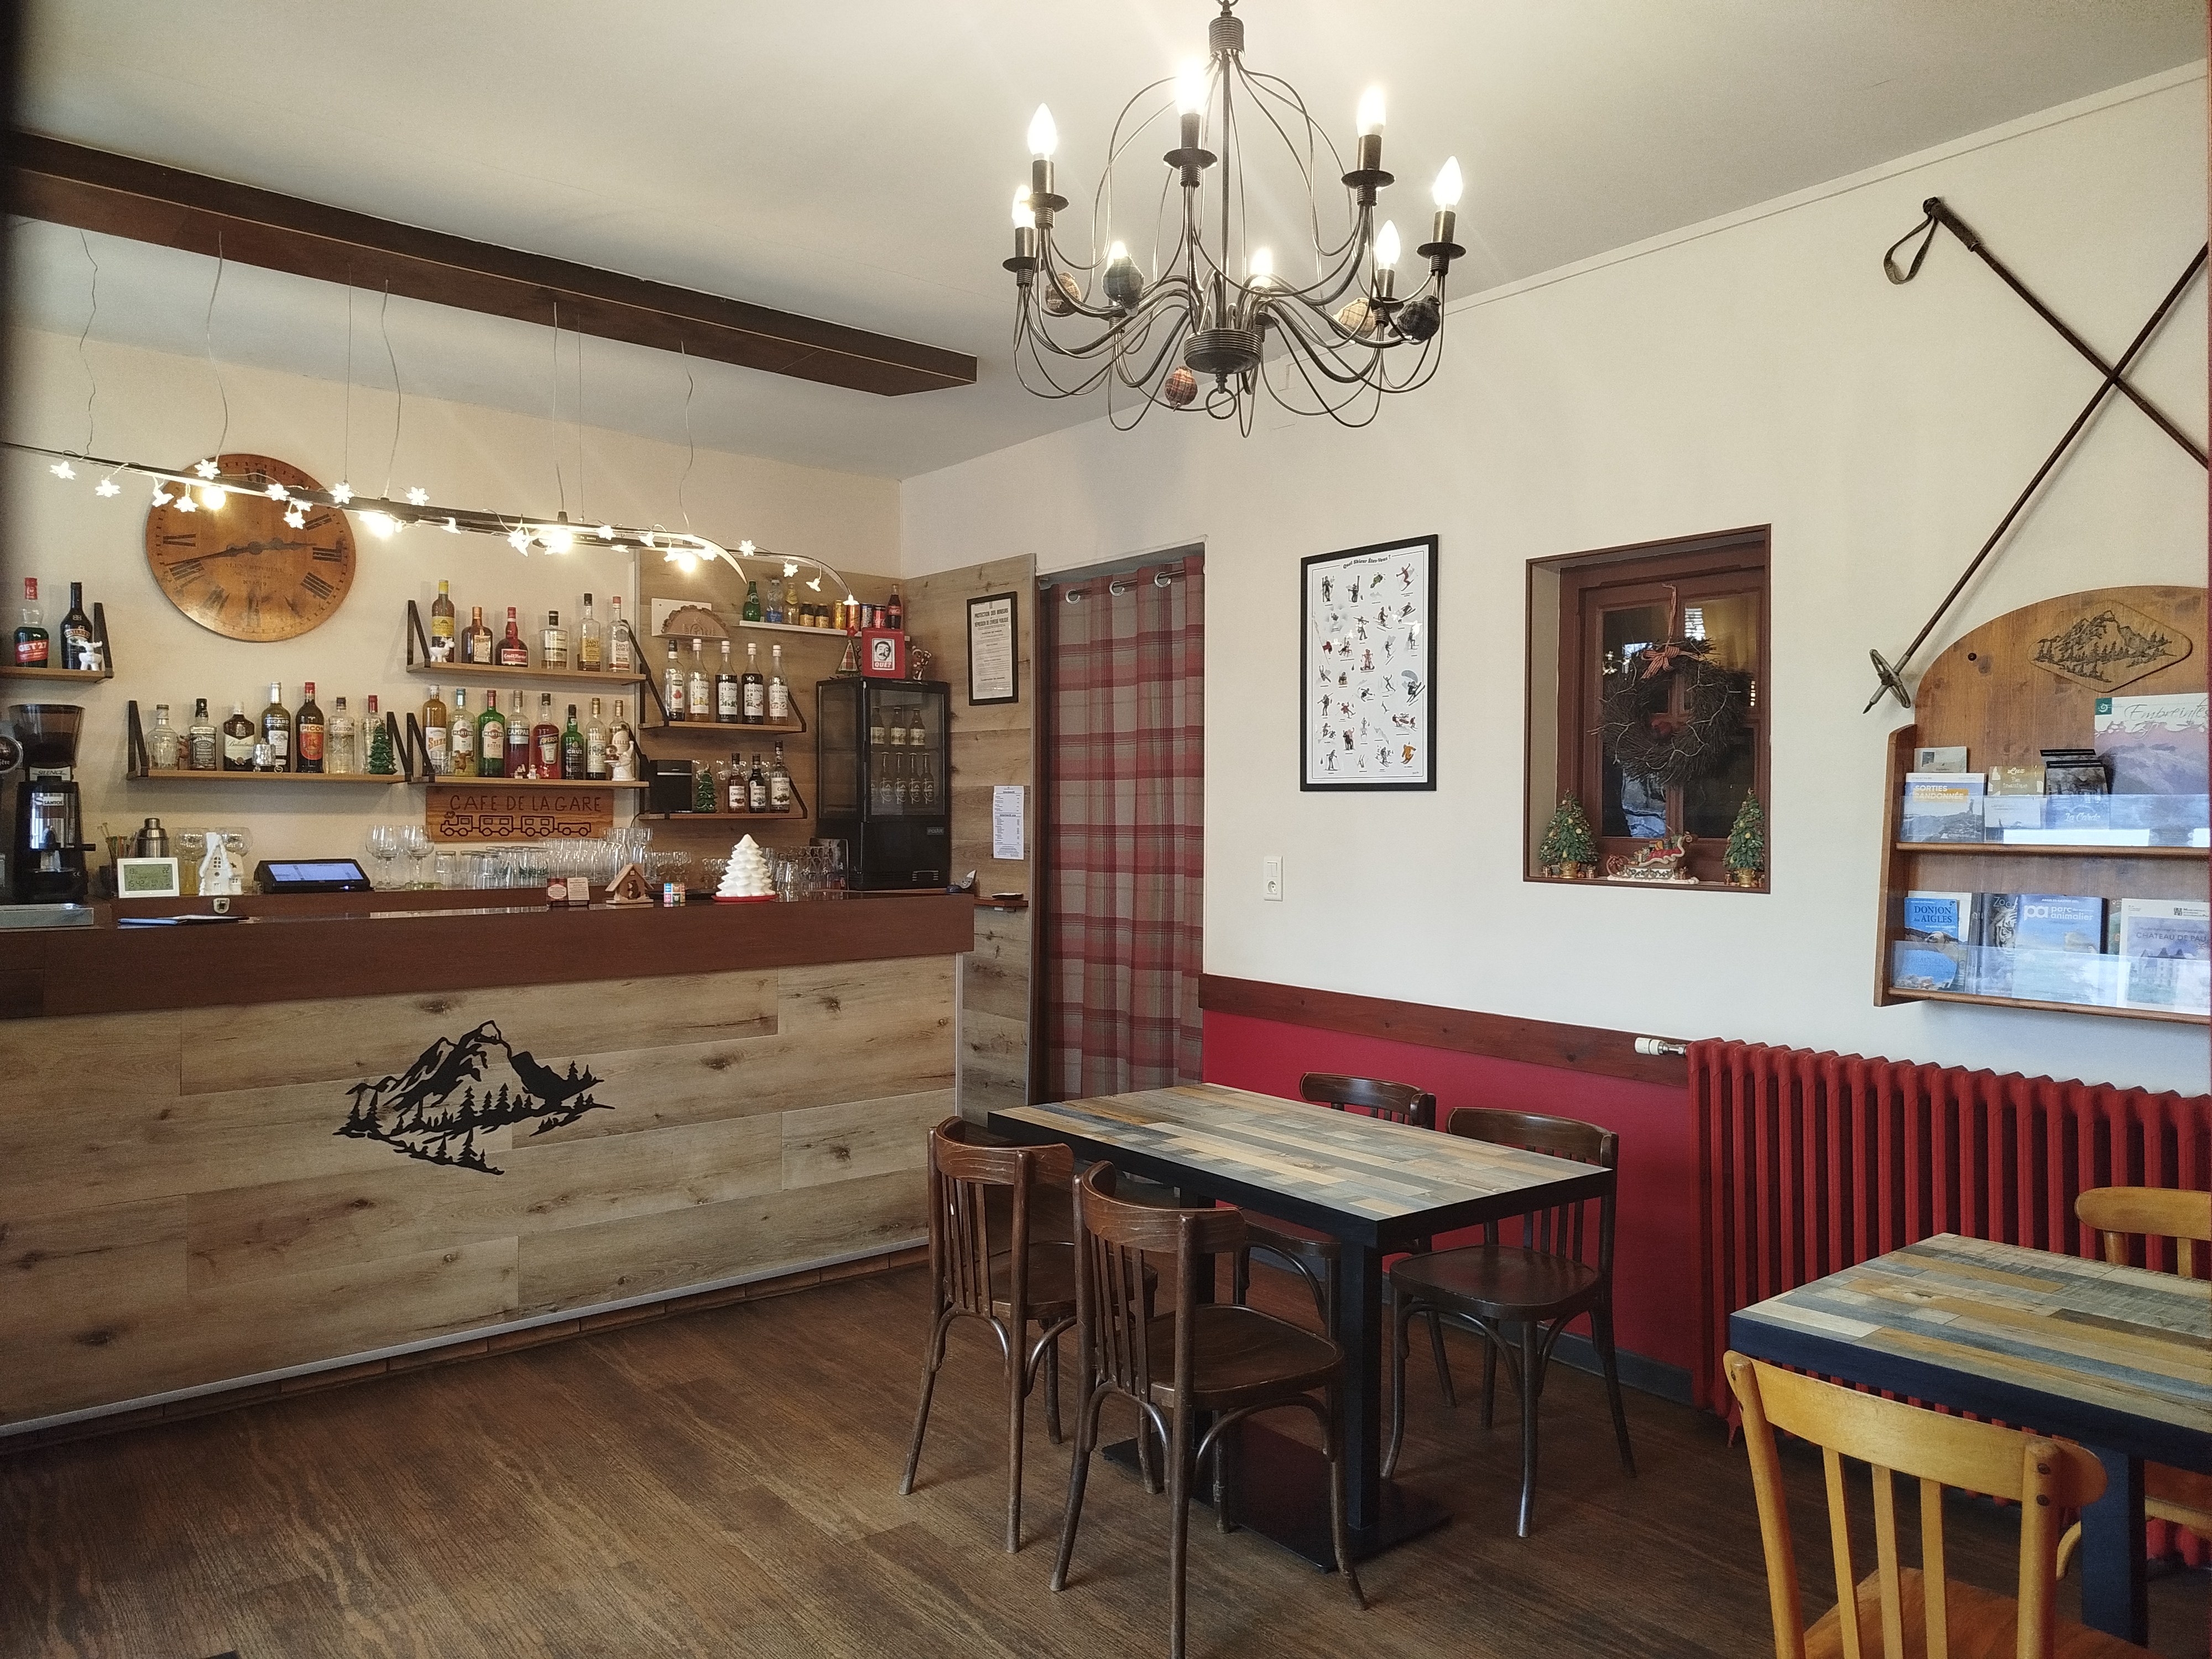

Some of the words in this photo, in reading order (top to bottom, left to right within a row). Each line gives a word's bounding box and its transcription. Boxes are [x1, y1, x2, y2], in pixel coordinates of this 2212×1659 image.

[18, 642, 36, 651] GET
[507, 796, 525, 811] DE
[531, 796, 549, 811] LA
[555, 796, 602, 811] GARE
[1993, 896, 2011, 908] Zoo
[1914, 906, 1952, 915] DONJON
[2051, 912, 2094, 920] animalier
